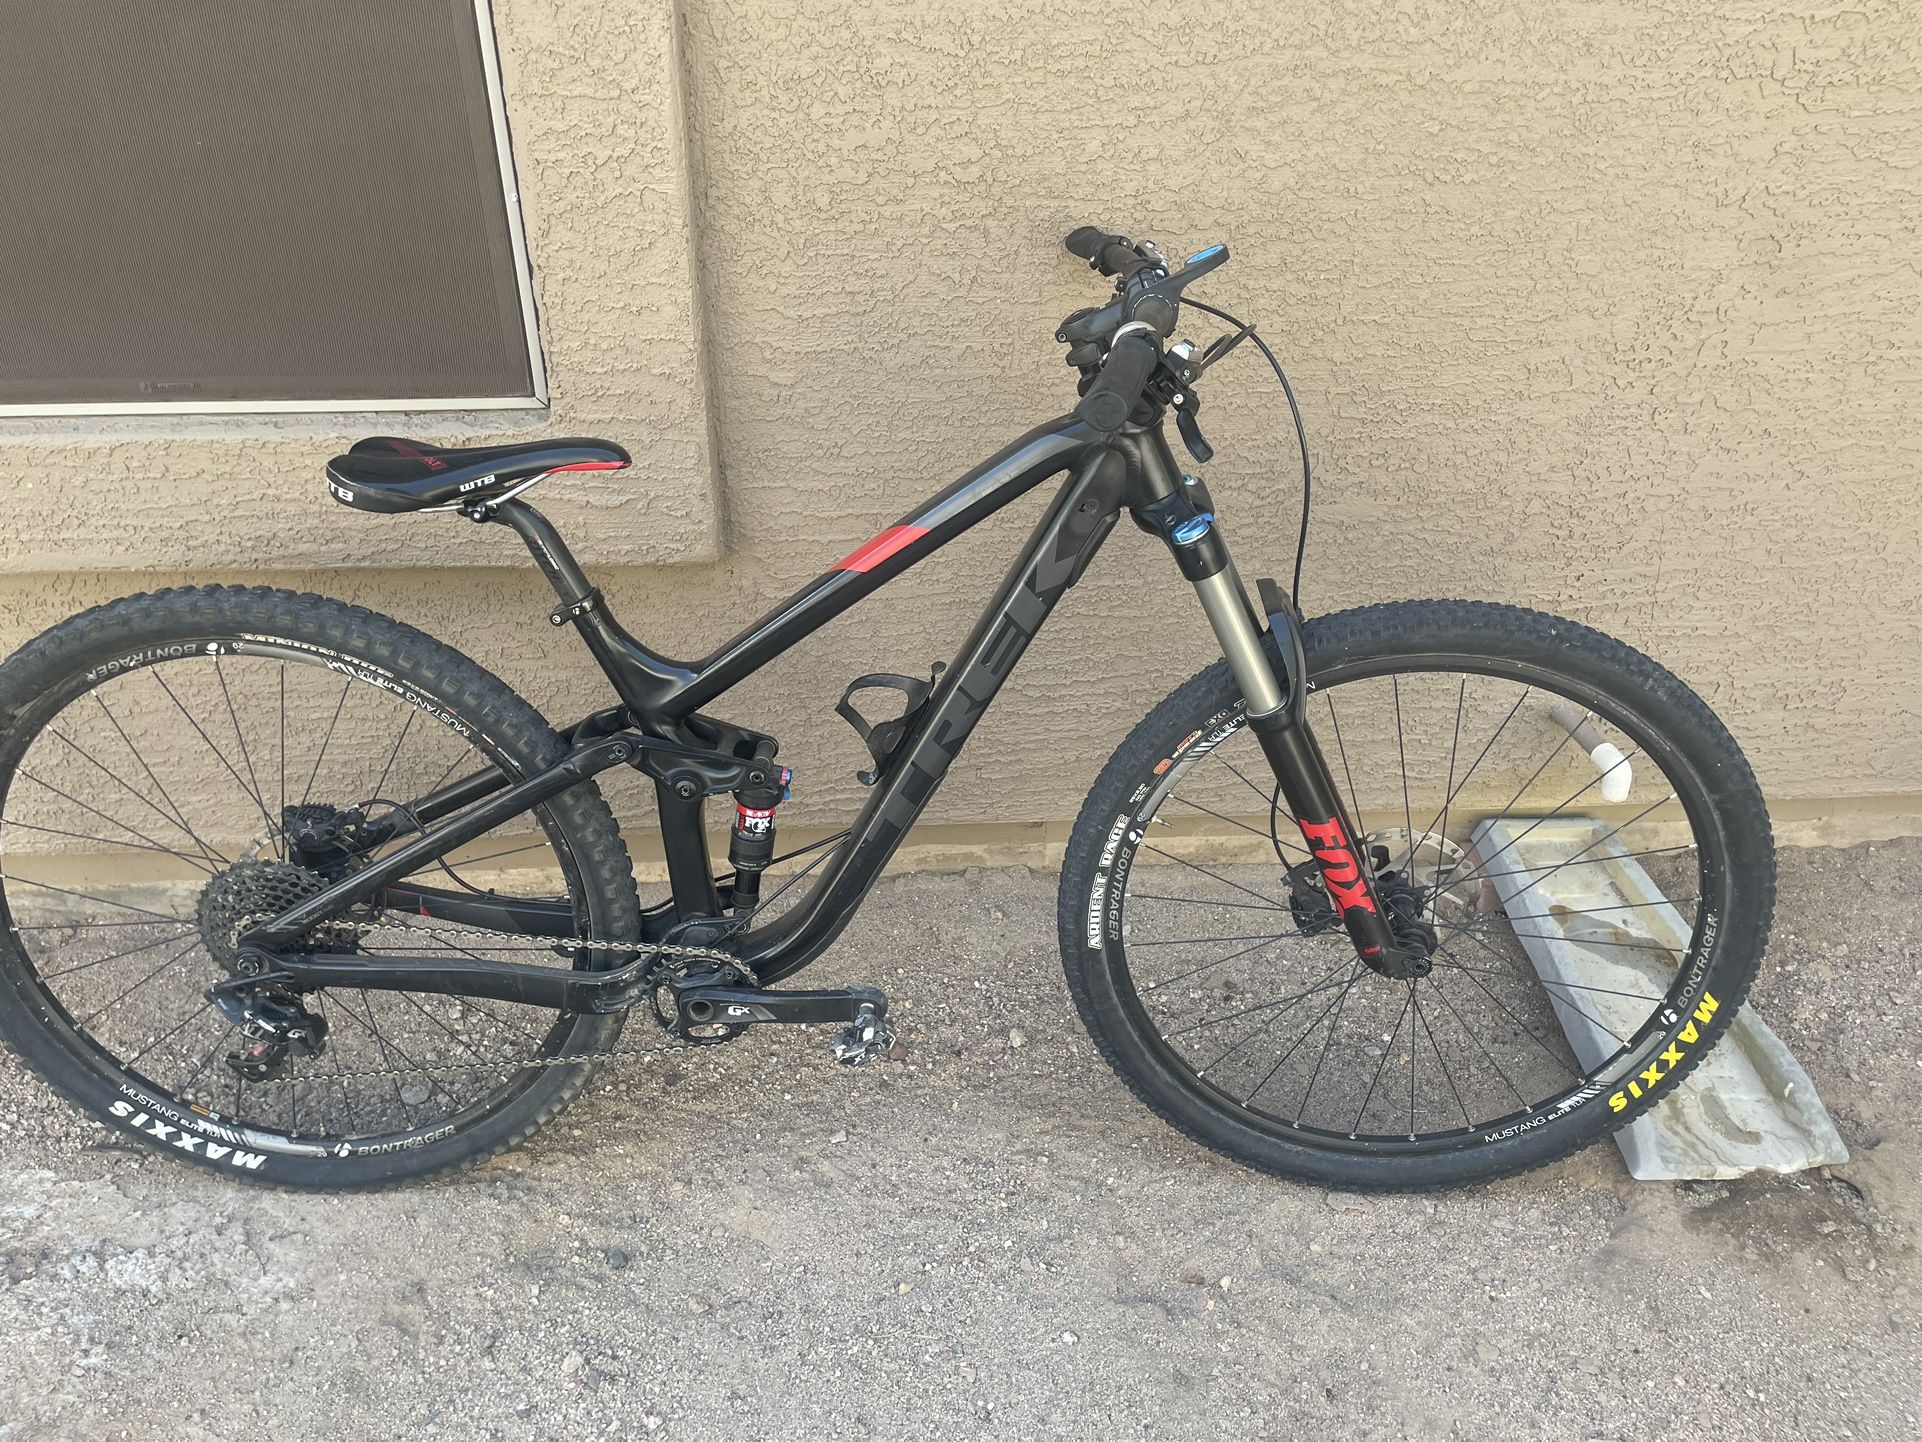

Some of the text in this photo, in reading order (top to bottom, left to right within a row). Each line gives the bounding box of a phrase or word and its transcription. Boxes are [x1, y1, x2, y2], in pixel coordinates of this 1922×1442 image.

[326, 477, 354, 502] TB
[459, 474, 496, 492] WTB
[86, 643, 197, 682] BONTRAGER
[377, 678, 404, 694] ELITE
[867, 527, 1079, 842] TREK
[406, 692, 470, 737] MUSTANG
[1208, 709, 1230, 727] EXO
[745, 816, 771, 833] FOX
[1088, 813, 1130, 950] ARDENT RACE
[1300, 816, 1377, 920] FOX
[1109, 846, 1131, 941] BONTRAGER
[1677, 914, 1719, 1009] BONTRAGER
[727, 1005, 751, 1016] GX
[1608, 991, 1720, 1113] MAXXIS
[119, 1083, 179, 1122] MUSTANG
[180, 1119, 204, 1133] ELITE
[1484, 1116, 1546, 1143] MUSTANG
[1547, 1107, 1571, 1121] ELITE
[108, 1100, 267, 1169] MAXXIS
[357, 1125, 457, 1156] BONTRAGER
